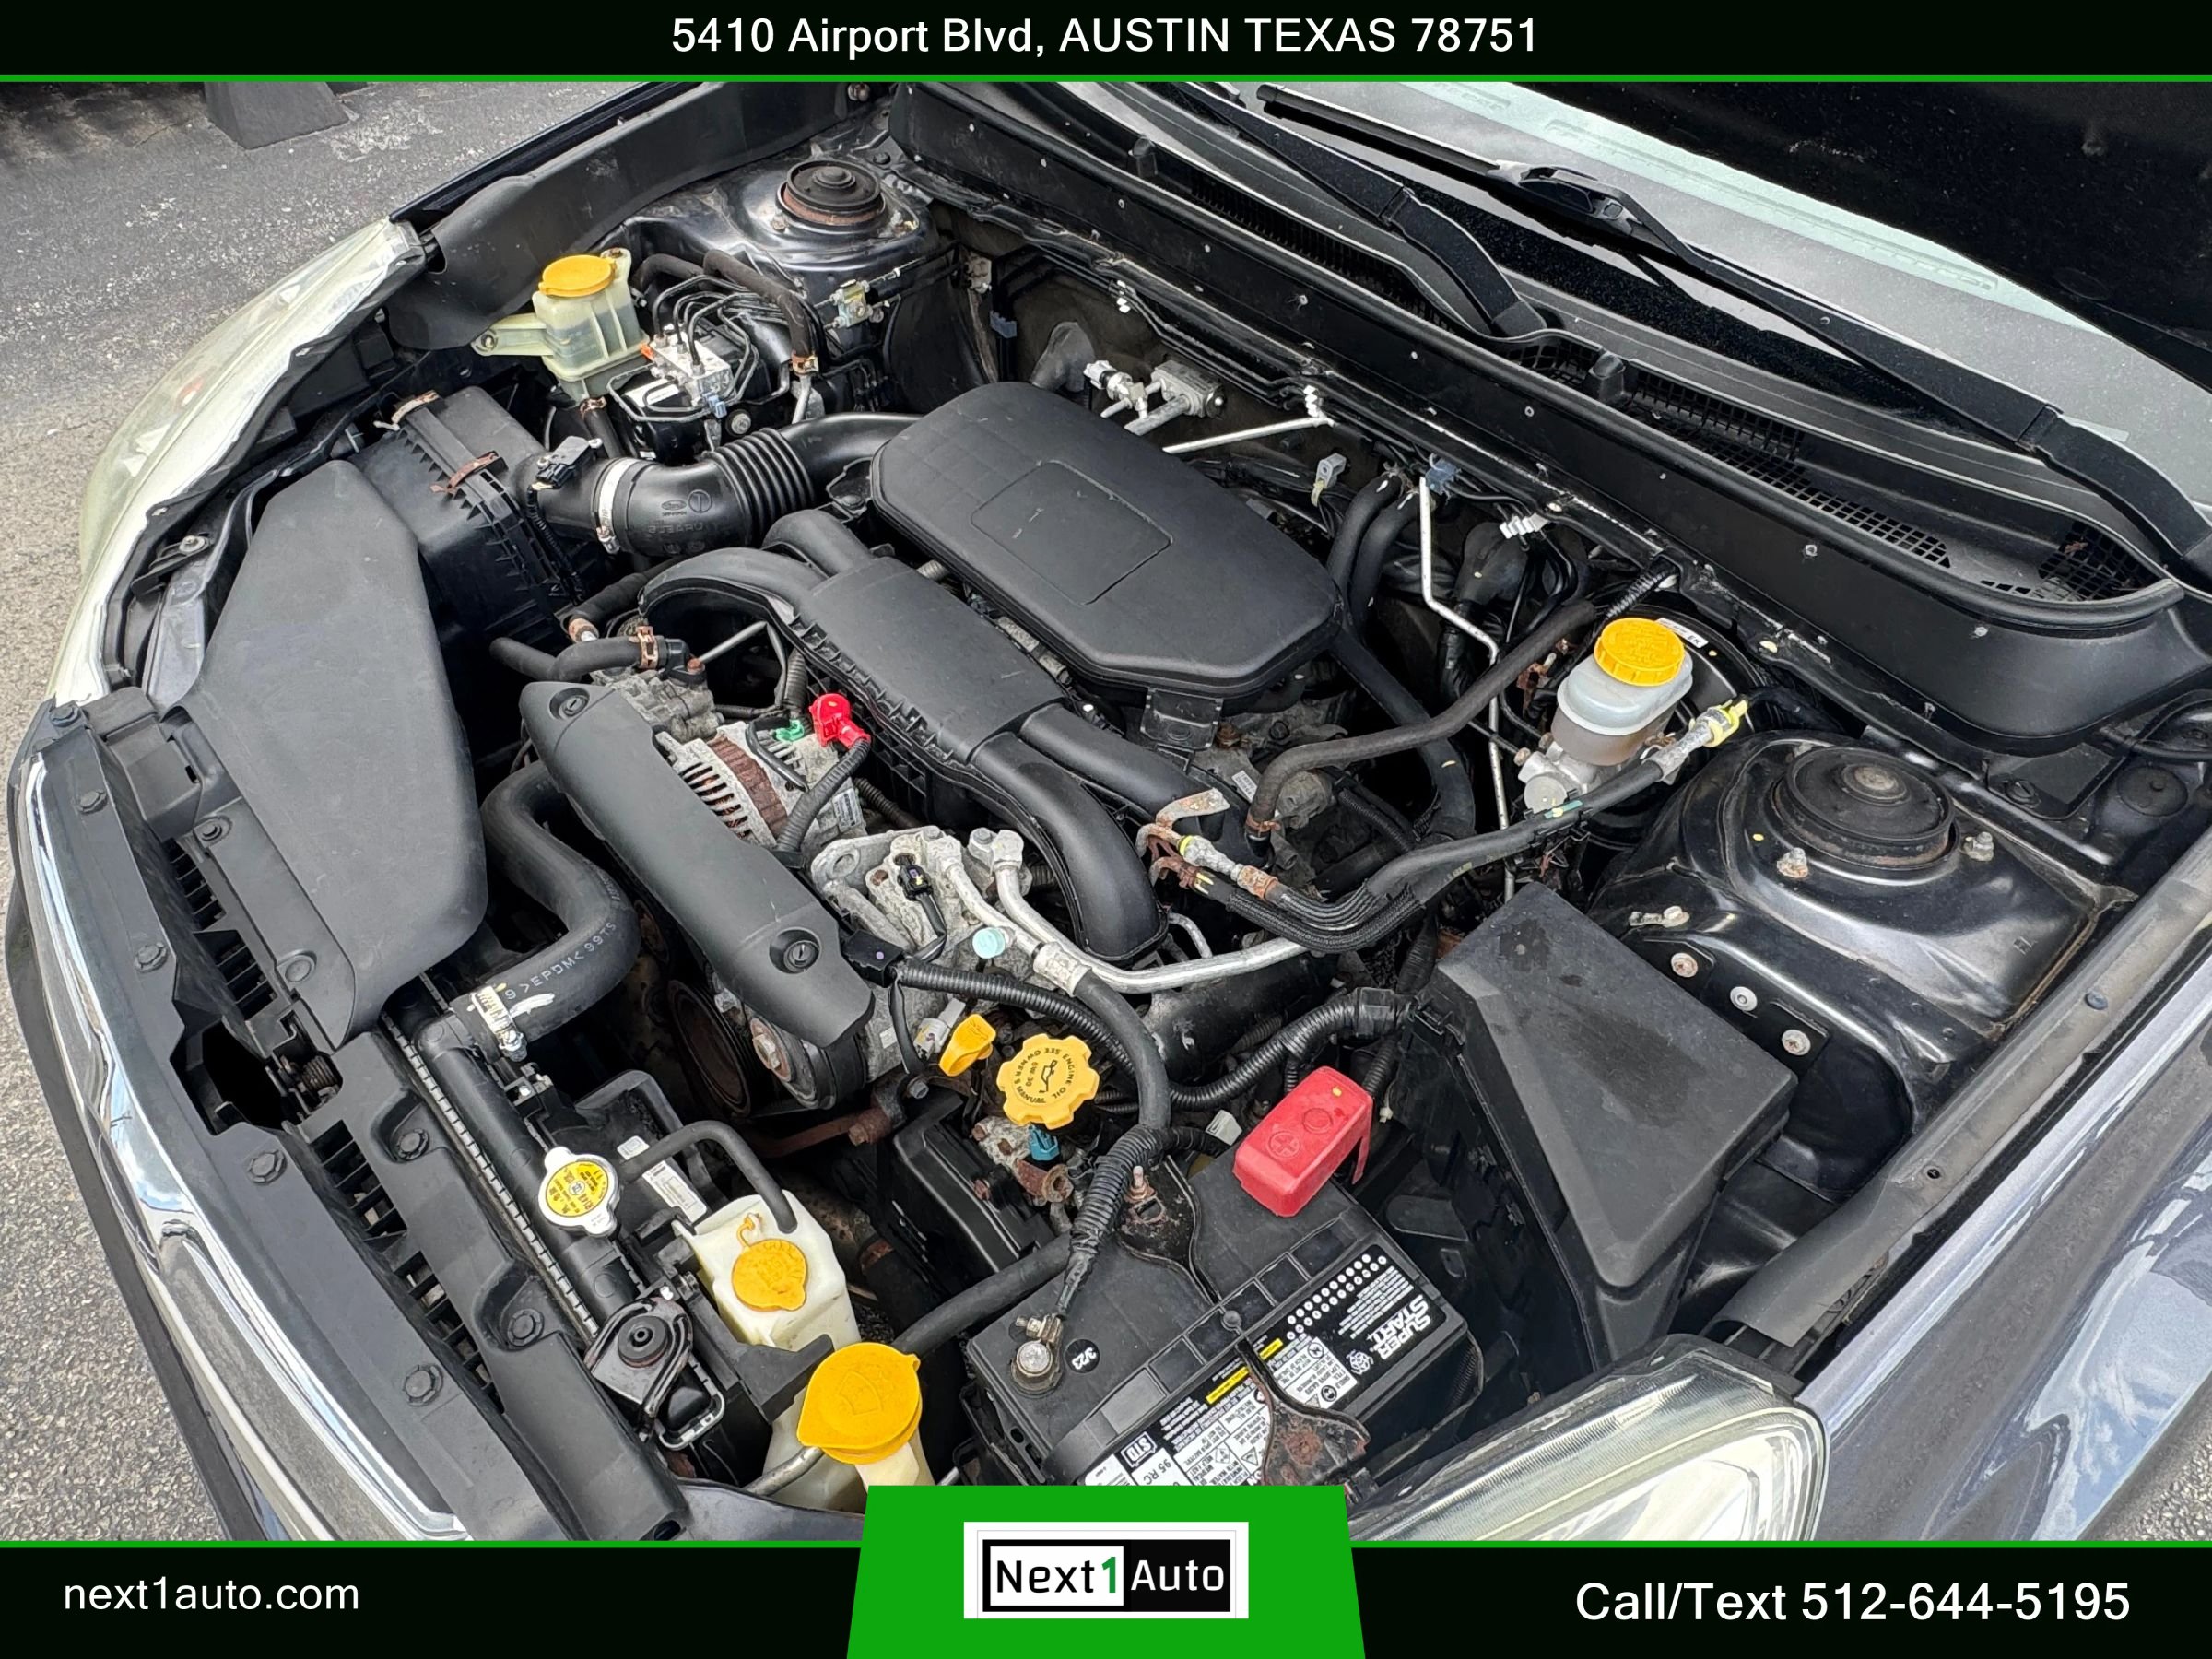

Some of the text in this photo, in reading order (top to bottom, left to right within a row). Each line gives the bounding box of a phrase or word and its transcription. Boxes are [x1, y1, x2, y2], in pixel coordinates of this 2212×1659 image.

[1052, 1053, 1075, 1099] ENGINE OIL
[1016, 1085, 1046, 1103] MANUAL
[1370, 1294, 1430, 1349] START
[1375, 1314, 1431, 1360] SUPER
[1071, 1347, 1097, 1371] 3/23
[1125, 1437, 1152, 1460] STD
[1142, 1468, 1159, 1485] RC
[1157, 1458, 1171, 1473] 95
